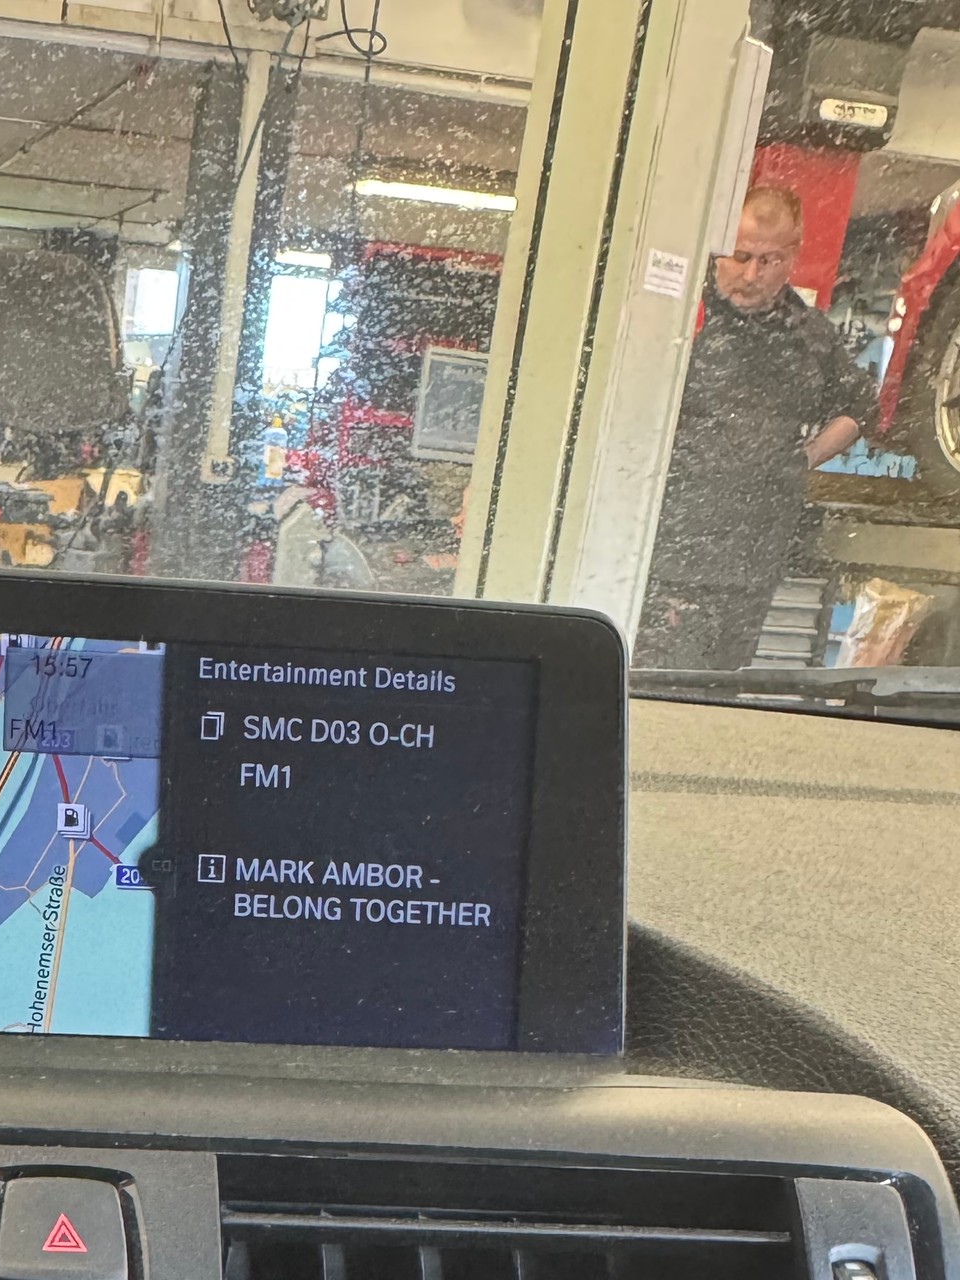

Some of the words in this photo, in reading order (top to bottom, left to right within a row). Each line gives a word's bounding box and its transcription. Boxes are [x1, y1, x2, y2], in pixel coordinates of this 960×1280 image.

[32, 656, 93, 679] 15:57
[199, 657, 367, 688] Entertainment
[375, 667, 456, 693] Details
[10, 718, 57, 741] FM1
[243, 715, 303, 742] SMC
[310, 719, 360, 745] D03
[369, 722, 435, 748] O-CH
[240, 763, 291, 789] FM1
[120, 867, 143, 884] 20
[235, 857, 314, 884] MARK
[322, 861, 423, 889] AMBOR
[233, 893, 342, 921] BELONG
[349, 898, 491, 927] TOGETHER
